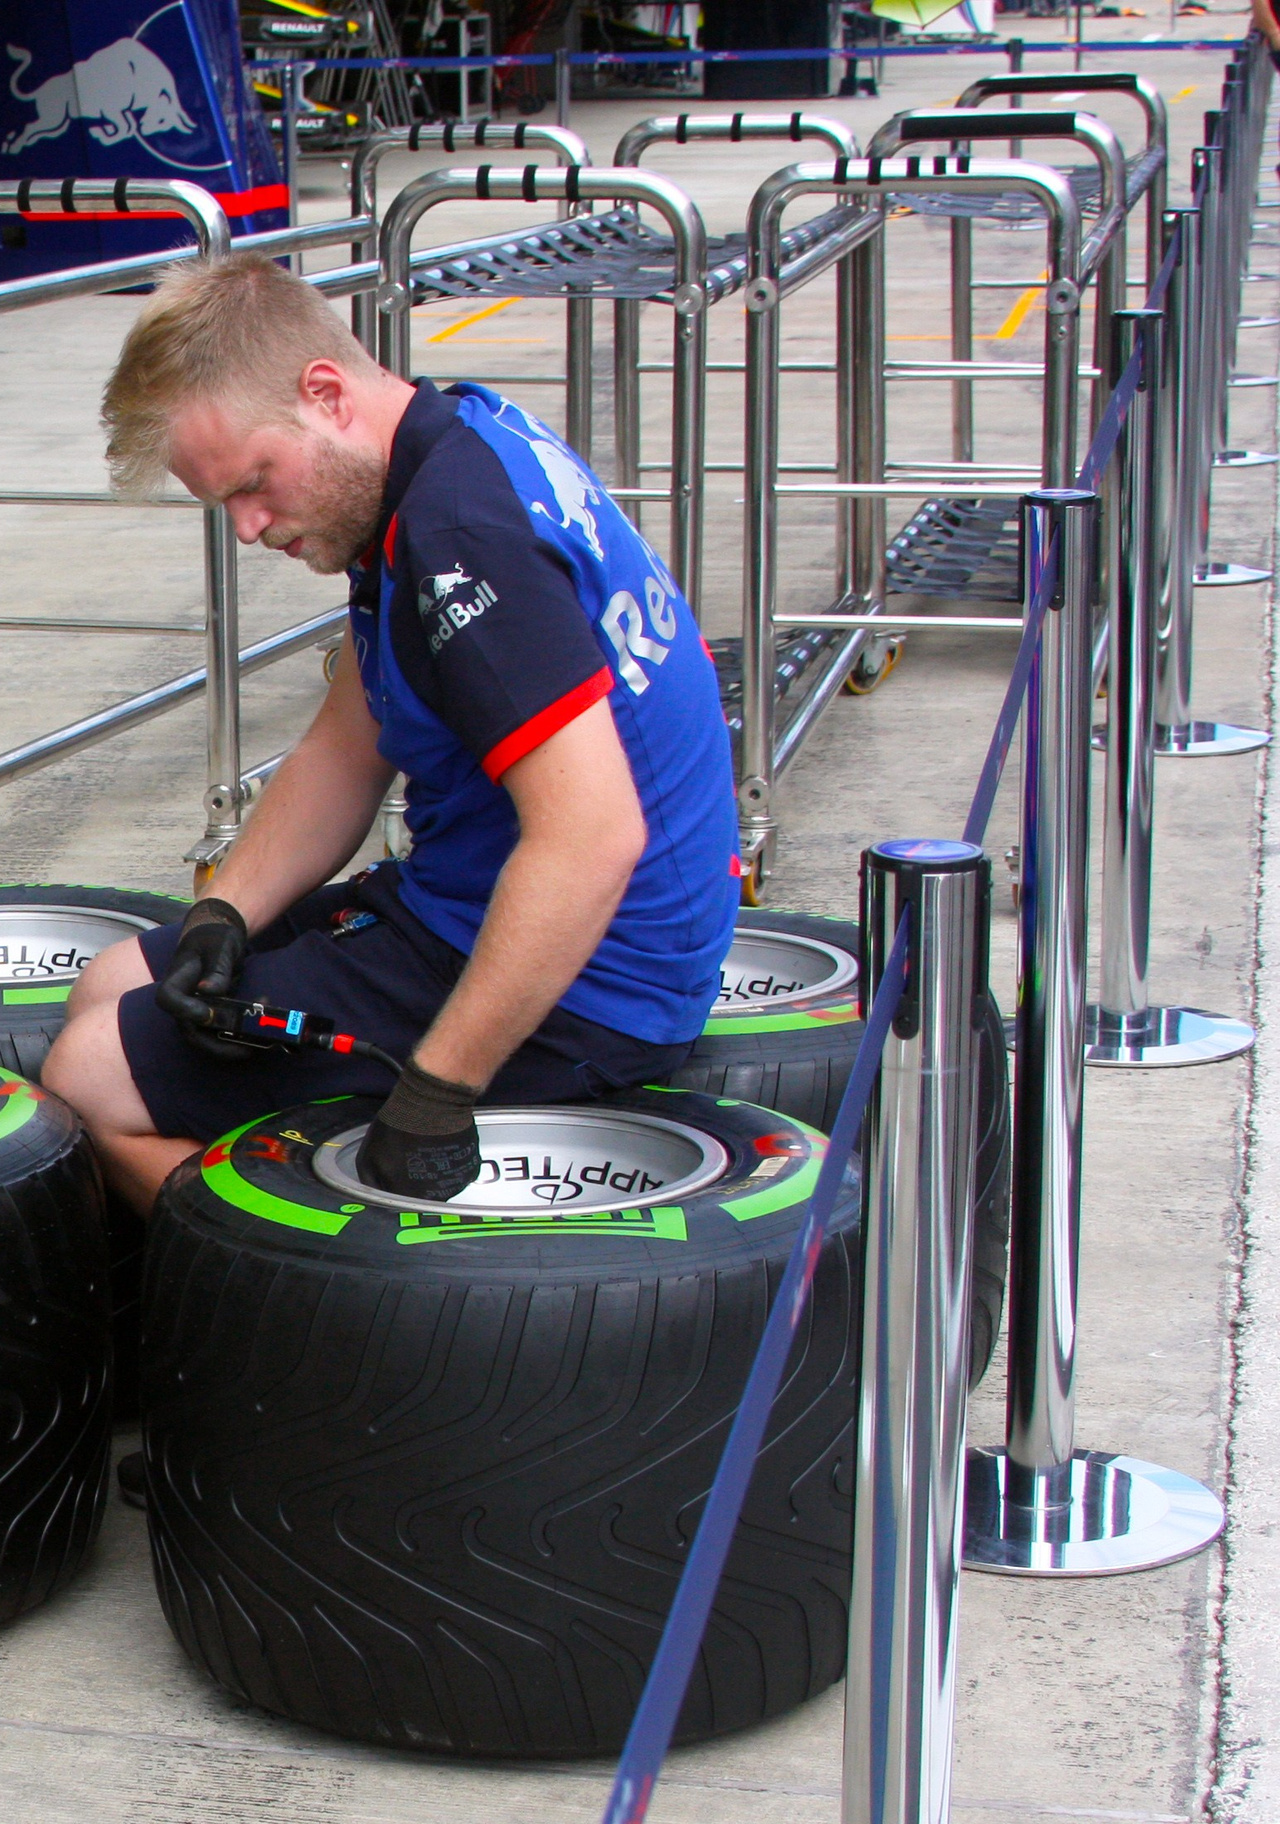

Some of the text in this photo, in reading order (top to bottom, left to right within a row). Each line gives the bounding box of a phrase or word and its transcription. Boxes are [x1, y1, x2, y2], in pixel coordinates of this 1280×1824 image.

[271, 23, 325, 33] RENAULT
[271, 118, 325, 129] RAULT
[476, 1156, 561, 1184] TEC
